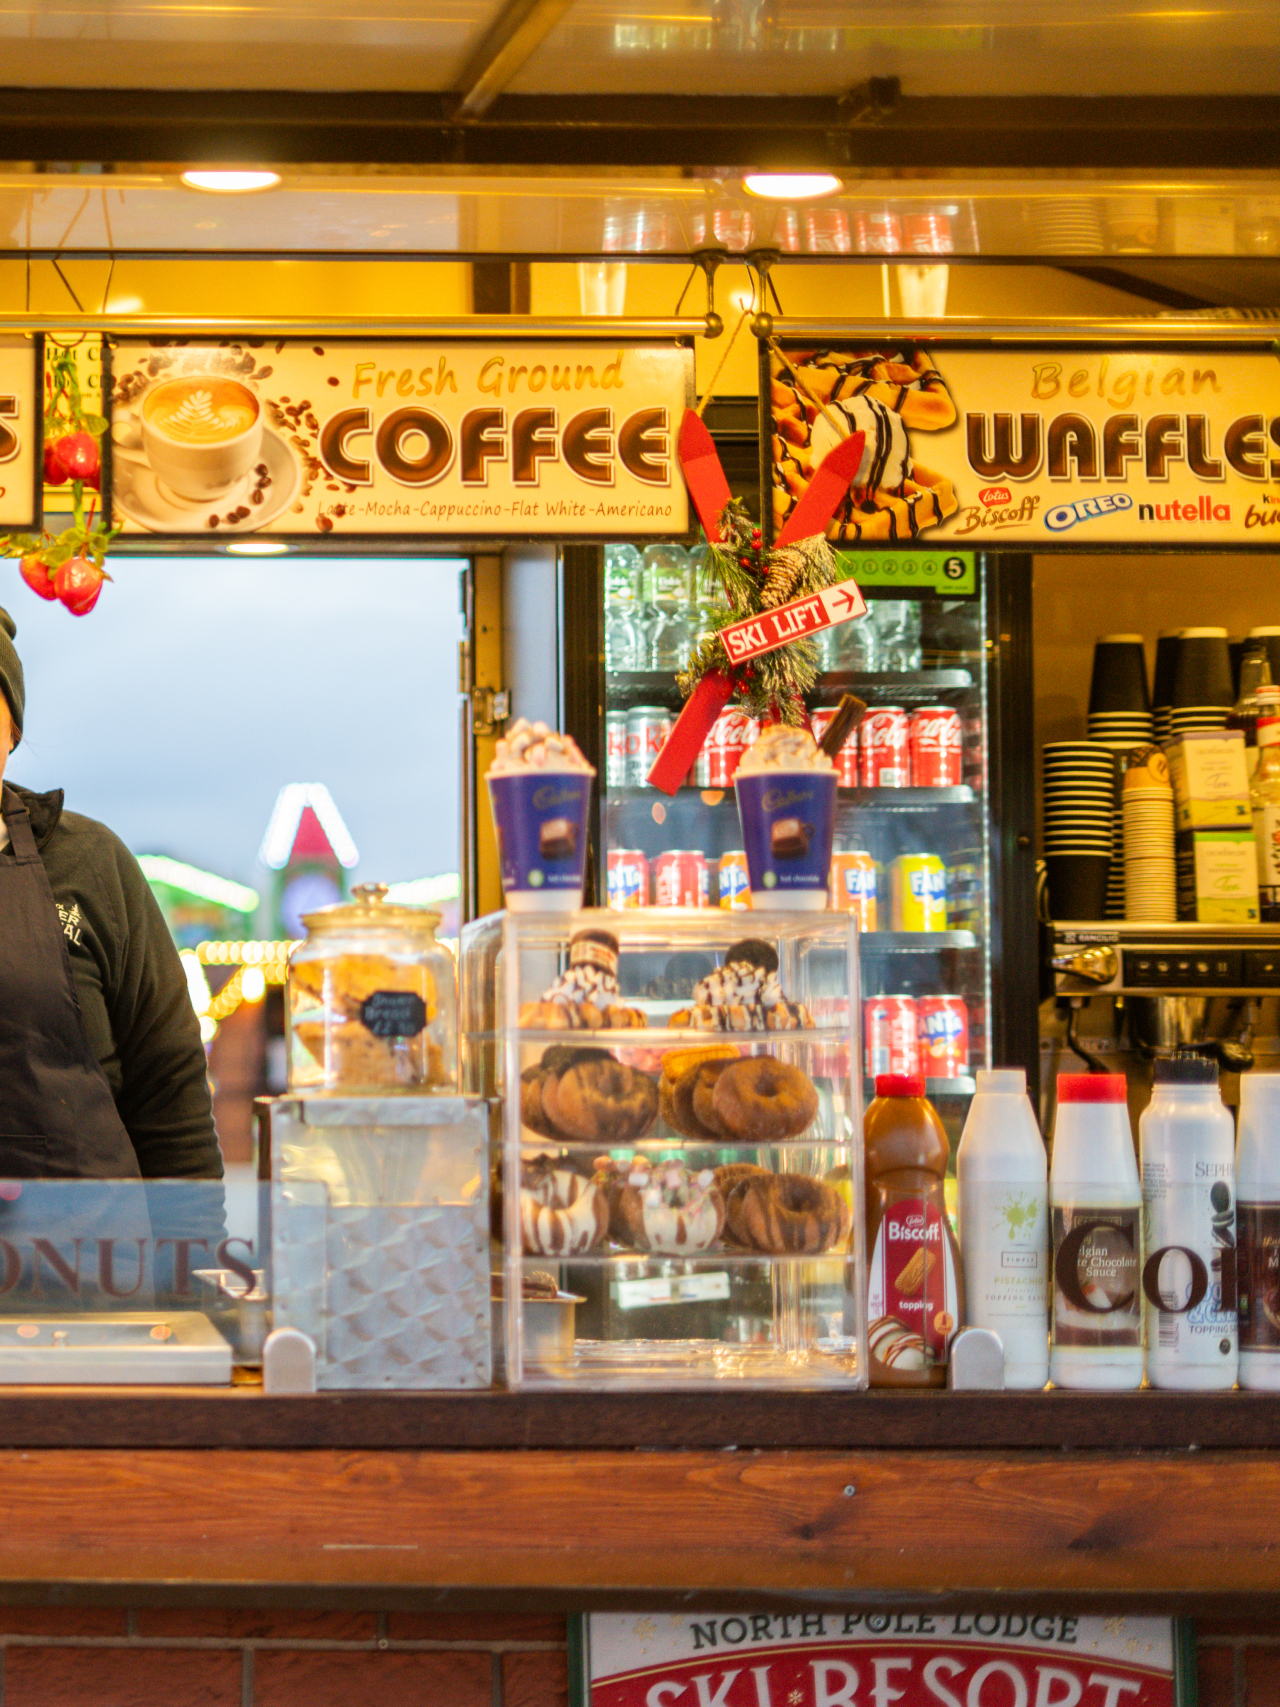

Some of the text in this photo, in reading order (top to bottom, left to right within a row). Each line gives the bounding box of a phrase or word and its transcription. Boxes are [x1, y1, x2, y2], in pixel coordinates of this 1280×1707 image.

[351, 352, 625, 399] Fresh Ground
[1031, 361, 1222, 409] Belgian
[318, 406, 672, 487] COFFEE
[954, 495, 1040, 535] Biscoff
[1044, 493, 1133, 532] OREO
[1139, 495, 1231, 521] nutella
[947, 558, 962, 578] 5
[727, 600, 824, 657] SKI LIFT
[888, 1222, 940, 1241] Biscoff
[1086, 1266, 1117, 1278] Sauce
[1090, 1257, 1137, 1268] Chocolate
[994, 1276, 1043, 1286] PISTACHIO
[899, 1301, 934, 1312] topping
[1189, 1325, 1228, 1335] TOPPING
[690, 1612, 1079, 1649] NORTH POLE LODGE
